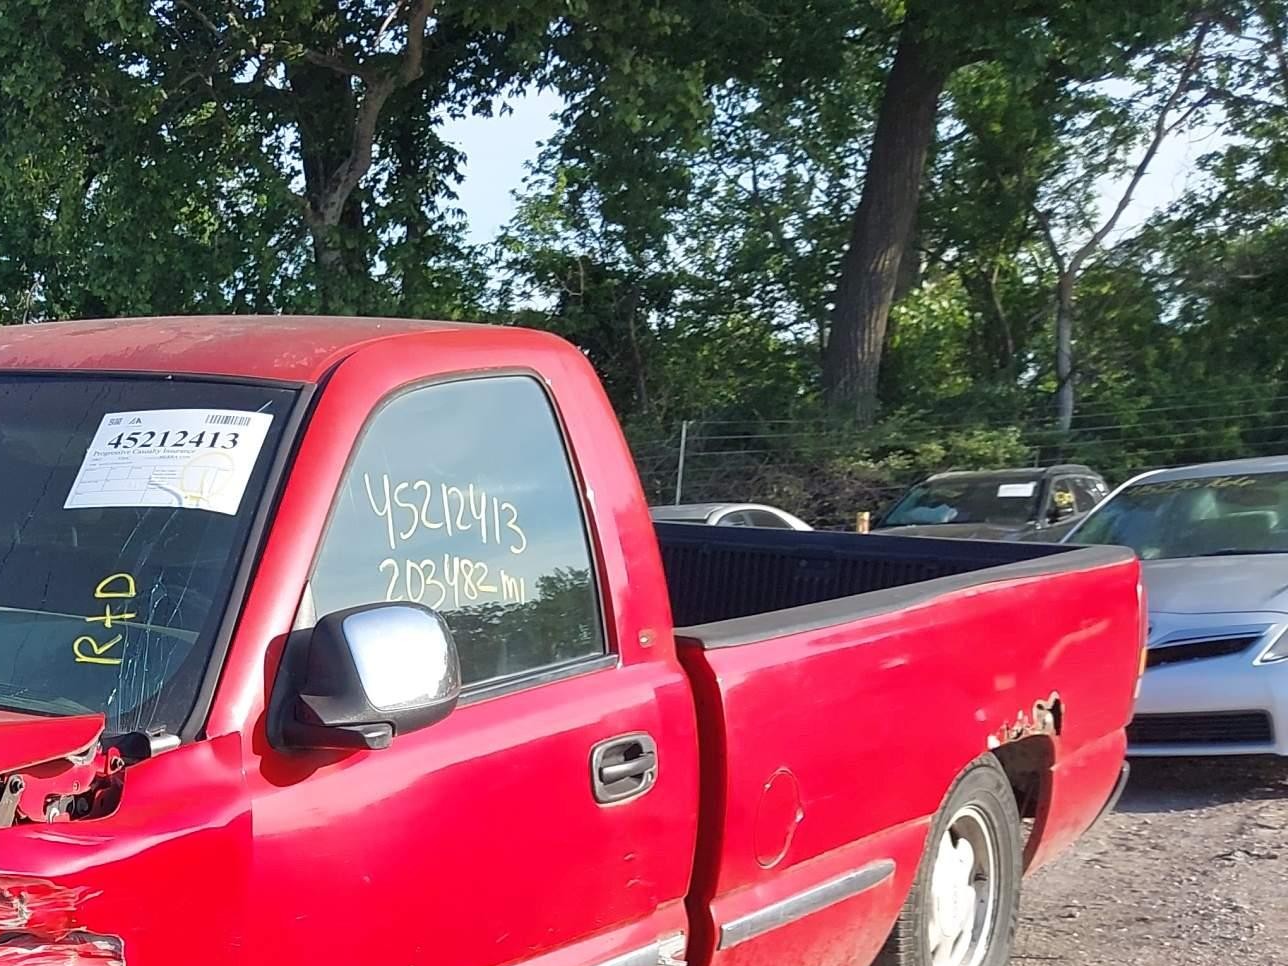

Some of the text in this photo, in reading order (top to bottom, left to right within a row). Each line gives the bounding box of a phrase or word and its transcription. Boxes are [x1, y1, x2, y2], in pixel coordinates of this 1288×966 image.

[107, 430, 241, 450] 45212413
[364, 472, 527, 554] 45212413
[379, 553, 498, 609] 203482
